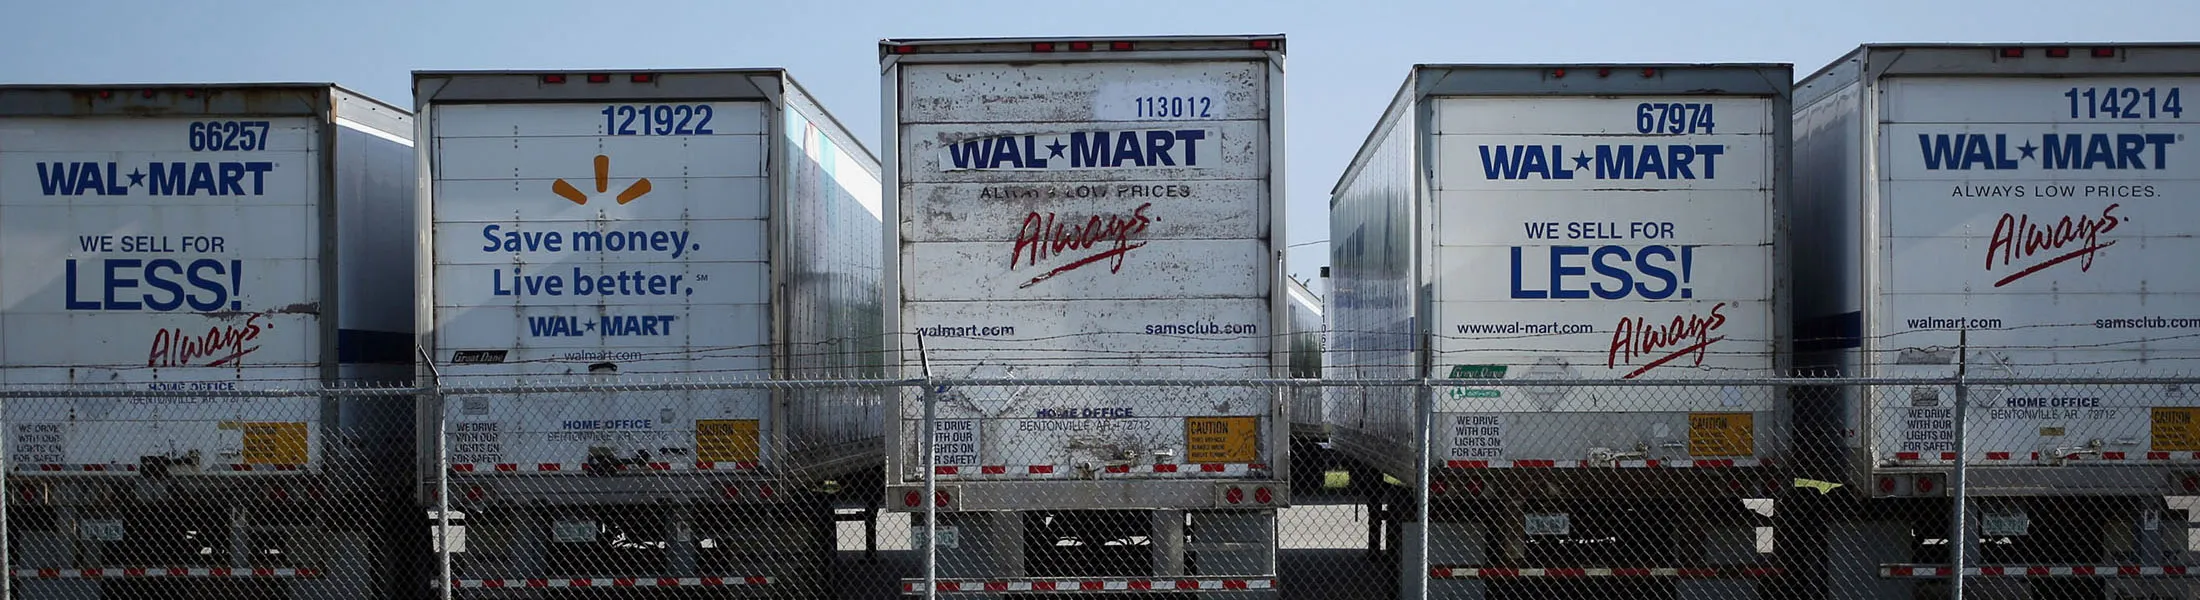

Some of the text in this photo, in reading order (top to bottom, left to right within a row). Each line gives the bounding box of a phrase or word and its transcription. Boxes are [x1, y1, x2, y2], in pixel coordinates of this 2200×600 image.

[1136, 96, 1211, 118] 113012
[2065, 88, 2182, 118] 114214
[602, 105, 713, 136] 121922
[1636, 103, 1714, 134] 67974
[190, 121, 270, 152] 66257
[1952, 185, 2161, 198] ALWAYS LOW PRICES.
[1524, 222, 1675, 239] WE SELL FOR
[80, 236, 225, 252] WE SELL FOR
[482, 224, 700, 259] Save money.
[1511, 246, 1693, 300] LESS!
[65, 259, 242, 311] LESS!
[494, 268, 563, 297] Live
[573, 267, 693, 297] better.
[1458, 320, 1593, 334] www.wal-mart.com
[1908, 316, 2001, 329] walmart.com
[2096, 316, 2200, 328] samsclub.com
[916, 324, 1015, 337] walmart.com
[1145, 322, 1257, 335] samsclub.com
[564, 349, 642, 360] walmart.com
[2008, 398, 2100, 407] HOME OFFICE
[1037, 408, 1133, 418] HOME OFFICE
[1908, 409, 1951, 418] WE DRIVE
[1991, 409, 2059, 420] BENTONVILLE
[563, 420, 652, 430] HOME OFFICE
[1020, 420, 1089, 431] BENTONVILLE
[1457, 416, 1499, 424] WE DRIVE
[1908, 420, 1952, 429] WITH OUR
[472, 422, 498, 432] DRIVE
[944, 422, 972, 430] DRIVE
[1191, 421, 1228, 434] CAUTION
[1456, 427, 1499, 436] WITH OUR
[936, 432, 972, 442] ITH OUR
[1906, 431, 1952, 440] LIGHTS ON
[1455, 438, 1500, 446] LIGHTS ON
[1904, 442, 1956, 450] FOR SAFETY
[934, 444, 974, 453] GHTS ON
[1472, 448, 1503, 456] SAFETY
[944, 455, 977, 464] SAFETY
